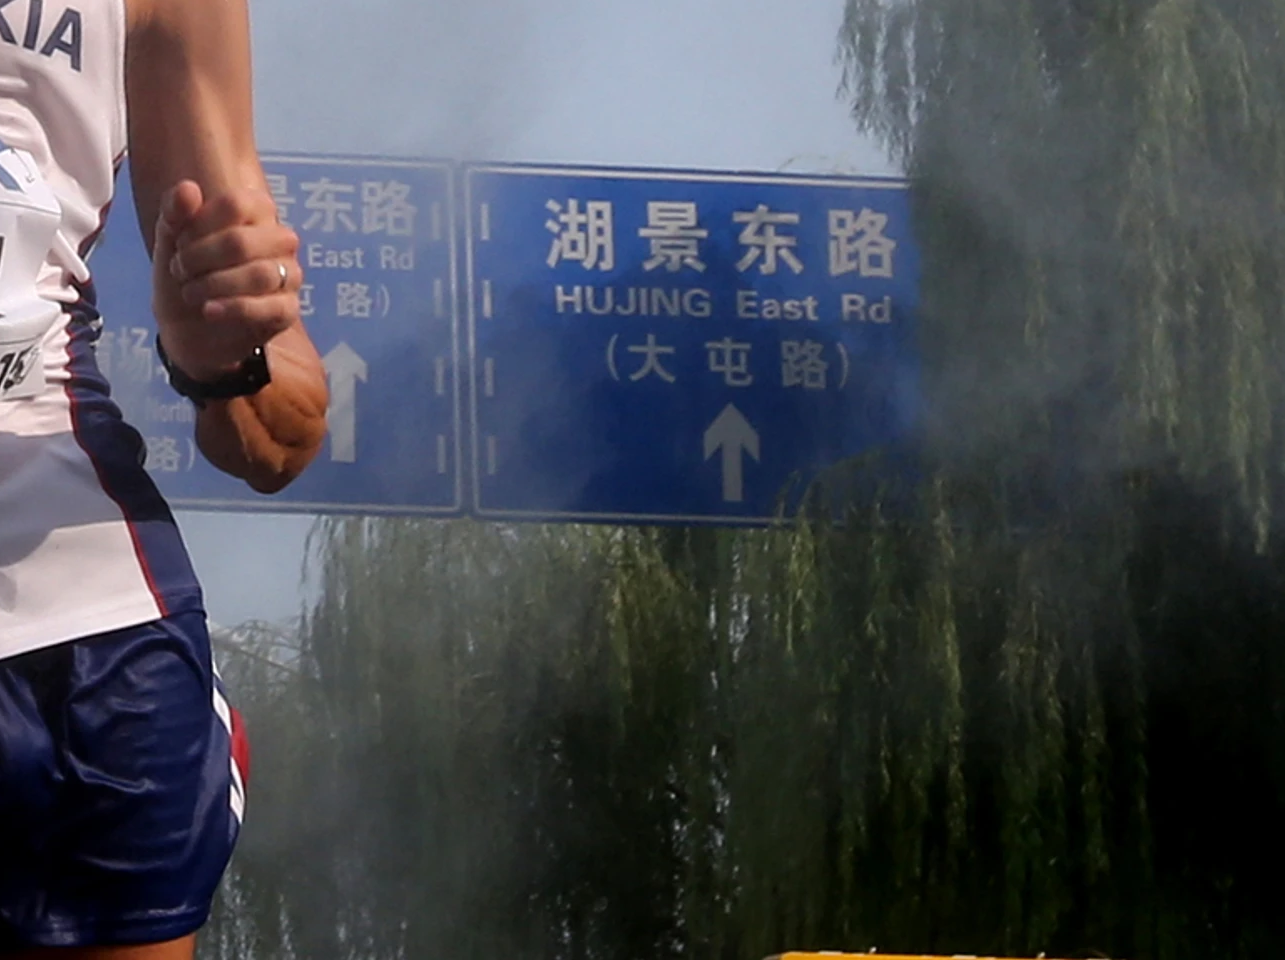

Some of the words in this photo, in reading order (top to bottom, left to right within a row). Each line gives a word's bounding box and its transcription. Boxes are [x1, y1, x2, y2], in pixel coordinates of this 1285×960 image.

[307, 243, 365, 269] East
[379, 244, 415, 270] Rd
[545, 198, 897, 279] 湖景东路
[555, 284, 712, 318] HUJING
[736, 289, 819, 322] East
[841, 292, 892, 324] Rd
